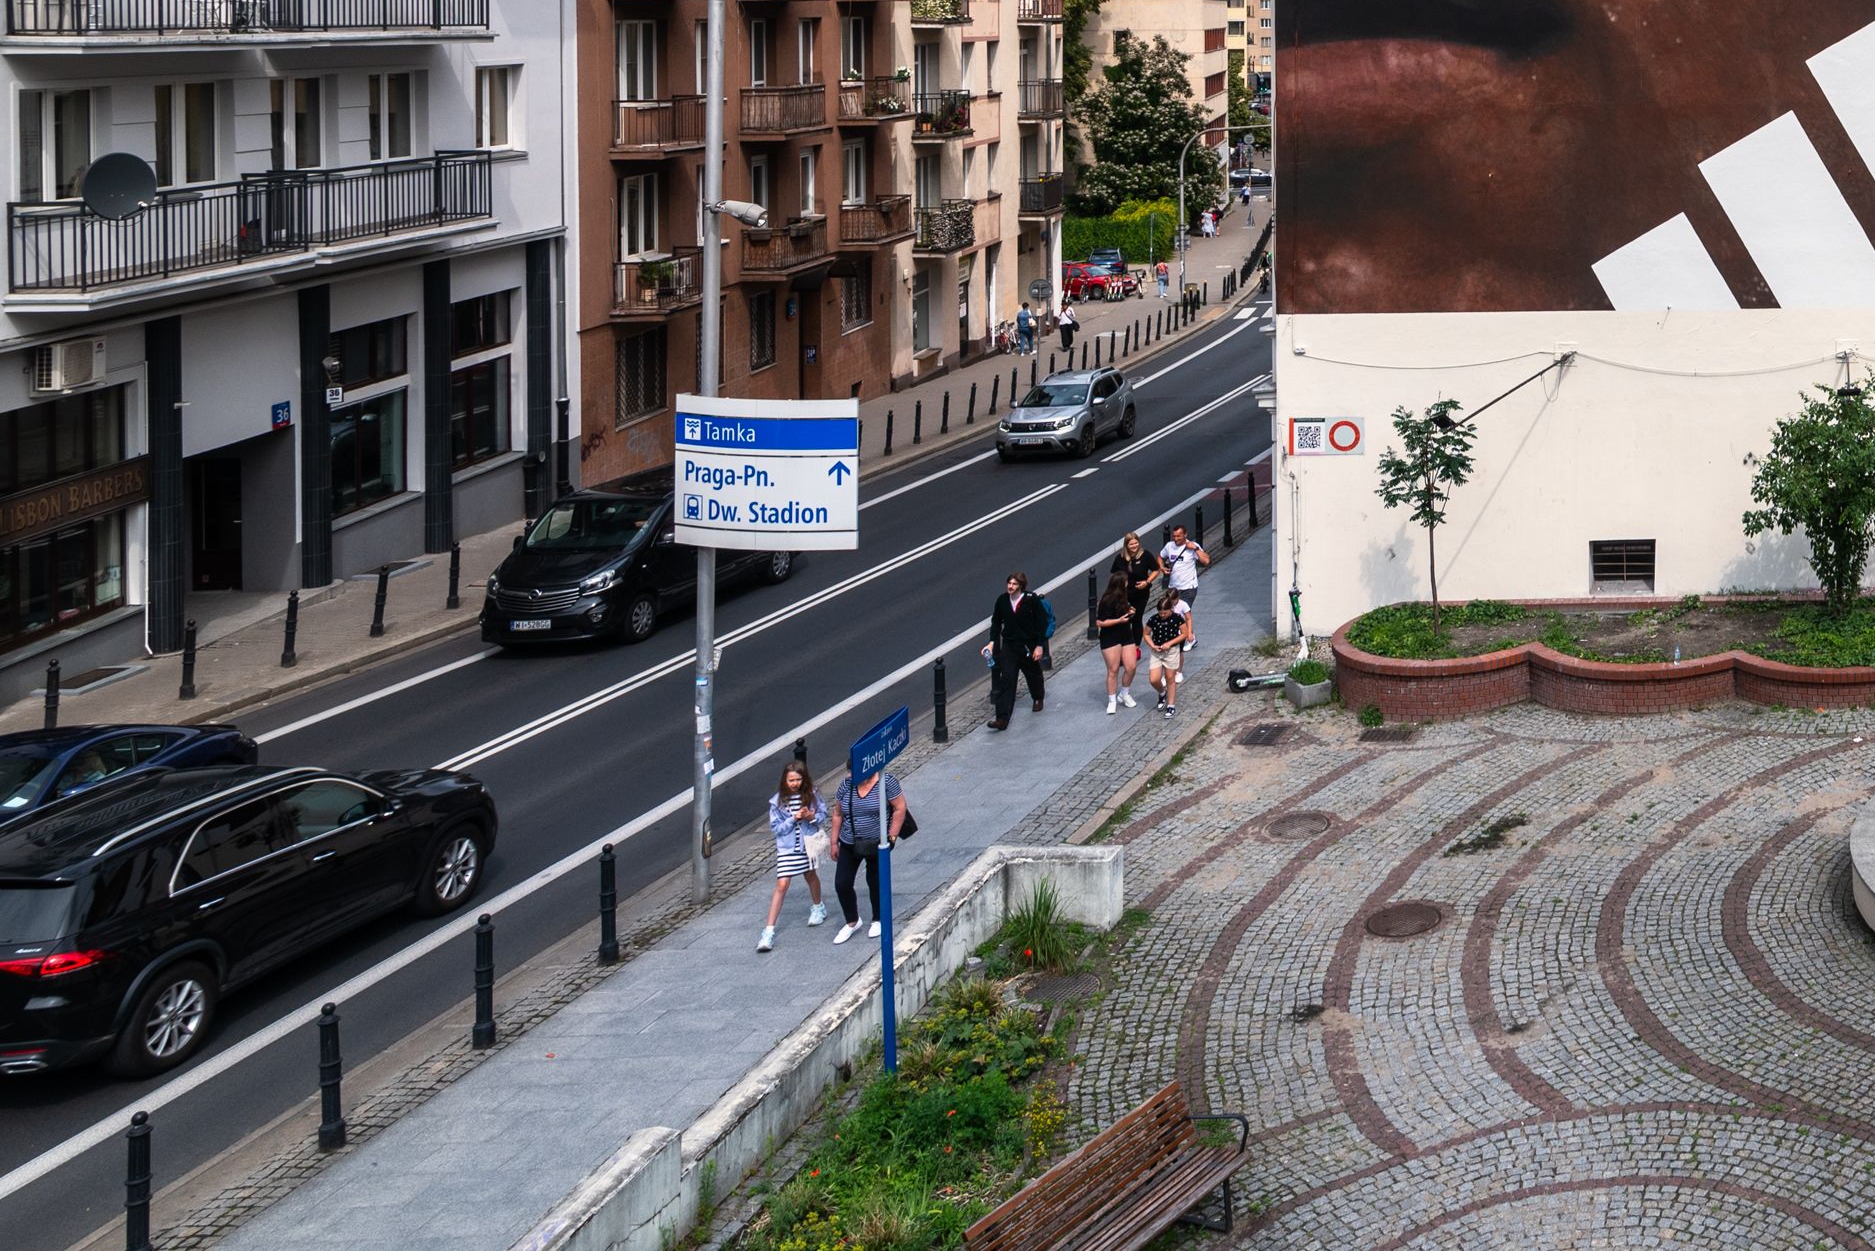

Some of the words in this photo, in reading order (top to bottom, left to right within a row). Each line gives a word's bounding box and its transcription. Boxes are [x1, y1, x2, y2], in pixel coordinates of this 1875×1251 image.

[277, 407, 289, 423] 36
[704, 421, 756, 443] Tamka
[685, 460, 775, 490] Praga-Pn.
[67, 468, 144, 514] BARBERS
[708, 499, 741, 522] Dw.
[748, 501, 828, 524] Stadion
[862, 744, 886, 773] Złotej
